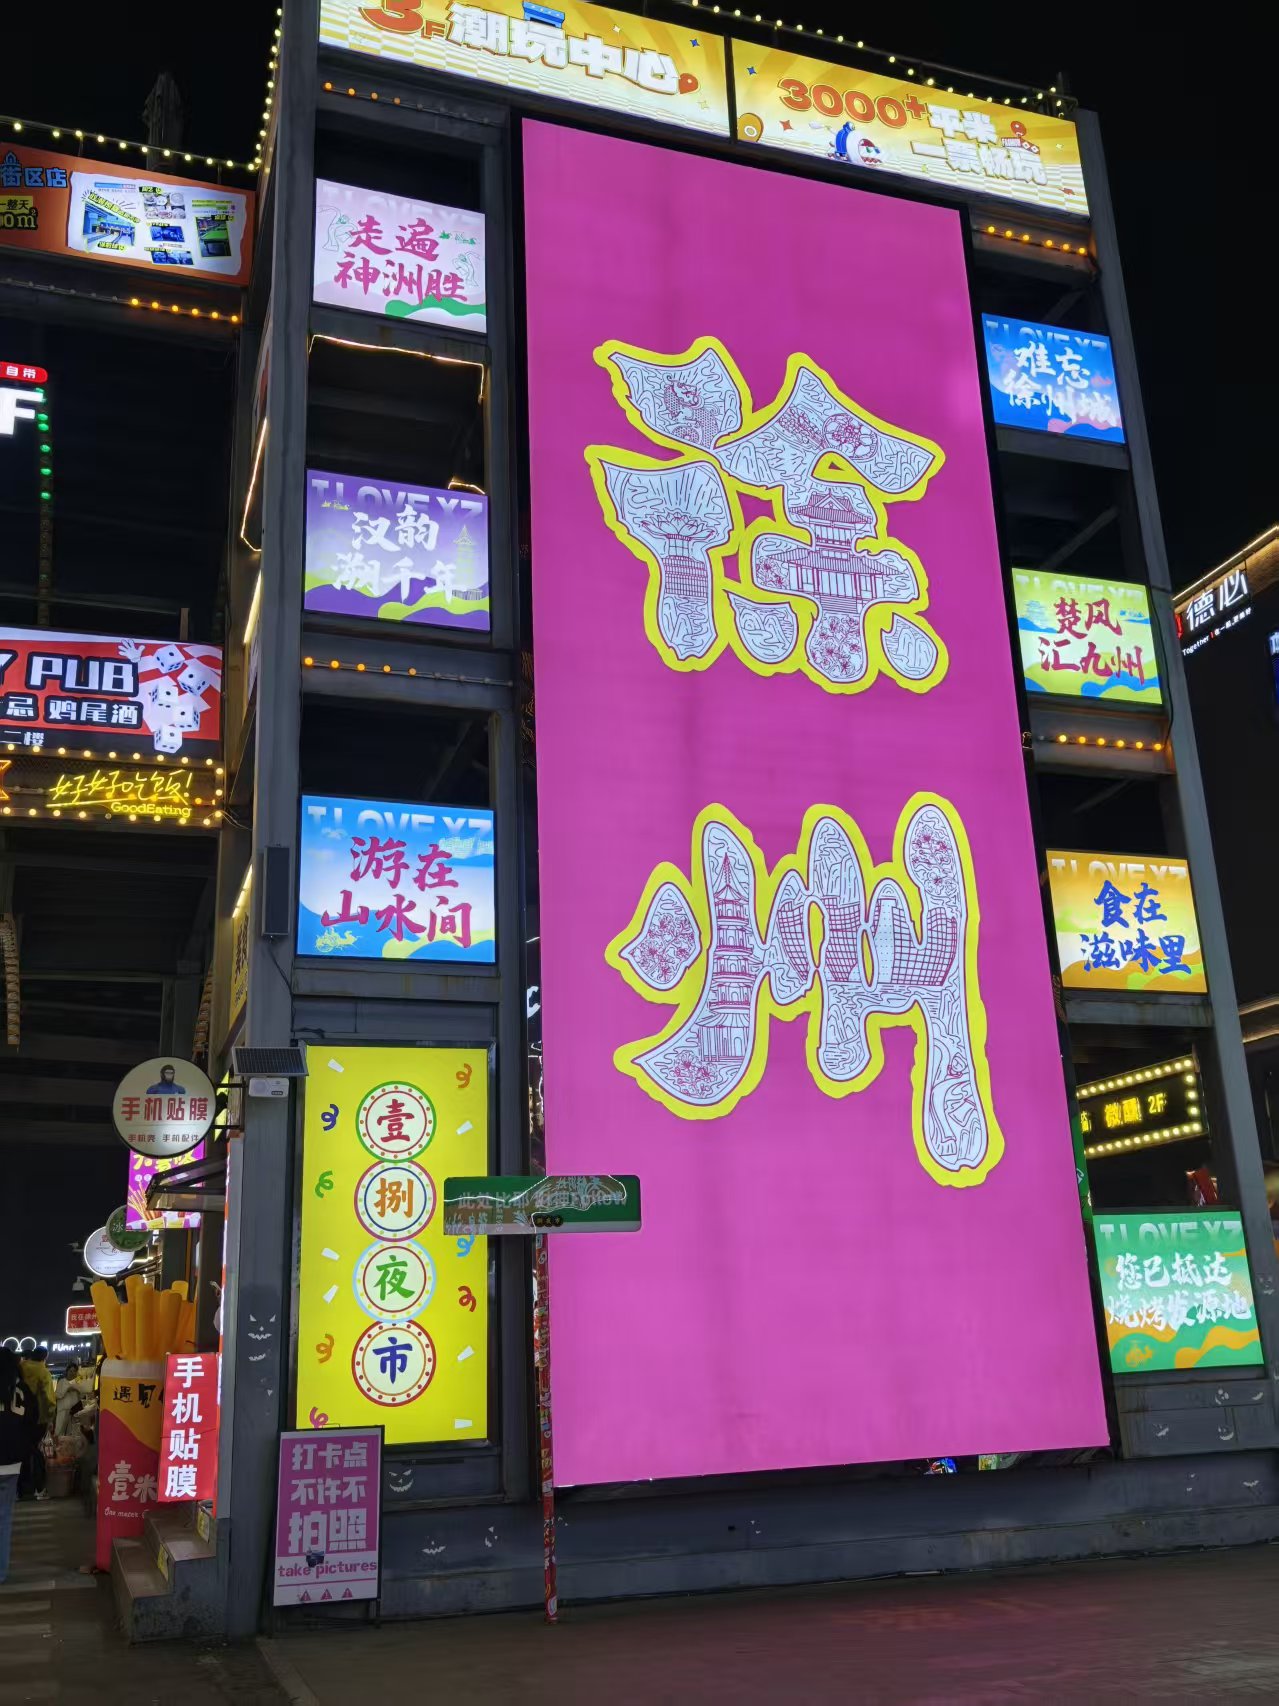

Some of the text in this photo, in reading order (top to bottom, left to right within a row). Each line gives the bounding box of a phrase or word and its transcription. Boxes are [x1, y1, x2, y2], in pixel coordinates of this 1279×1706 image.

[348, 214, 440, 261] 走遍
[333, 251, 468, 305] 神洲胜
[1013, 341, 1090, 389] 难忘
[351, 503, 440, 551] 汉韵
[1053, 597, 1122, 639] 楚风
[1186, 569, 1249, 632] 德必
[29, 655, 134, 693] PUB
[1038, 636, 1145, 685] 汇九州
[49, 699, 138, 726] 鸡尾酒
[350, 836, 459, 892] 游在
[320, 889, 473, 949] 山水间
[1093, 879, 1168, 929] 食在
[1079, 928, 1192, 975] 滋味里
[120, 1096, 209, 1121] 手机贴膜
[128, 1133, 200, 1143] 手机壳 手机配件
[371, 1098, 416, 1385] 壹捌夜市
[1115, 1251, 1233, 1291] 您已抵达
[164, 1356, 205, 1498] 手机贴膜
[291, 1442, 368, 1471] 打卡点
[290, 1475, 368, 1506] 不许不
[288, 1508, 368, 1554] 拍照
[277, 1560, 378, 1580] take pictures
